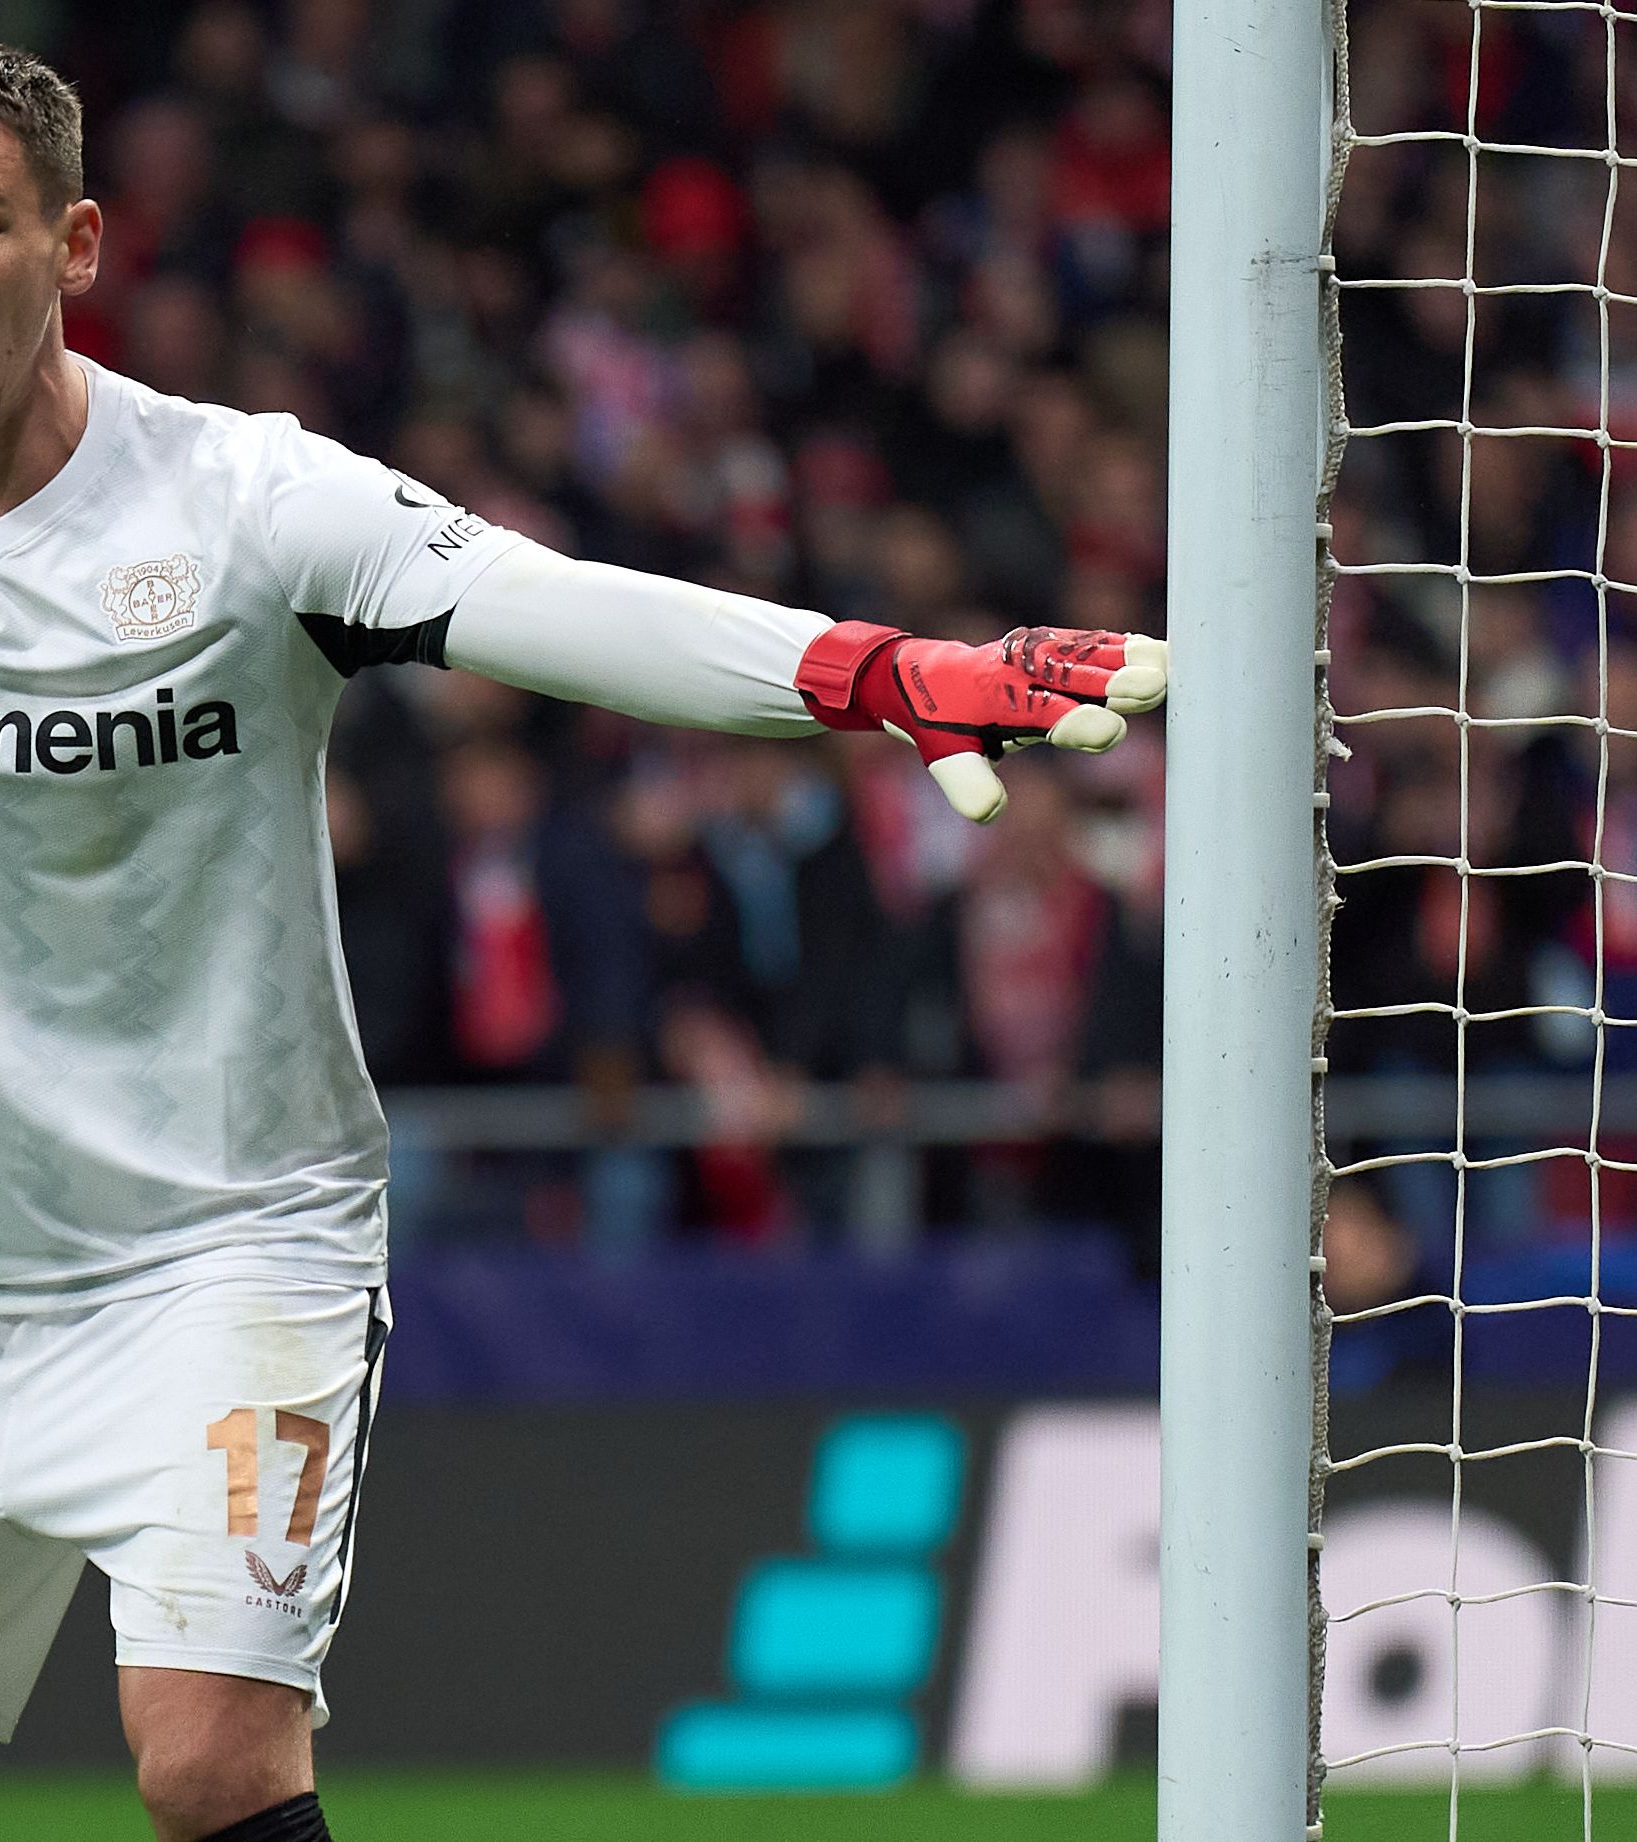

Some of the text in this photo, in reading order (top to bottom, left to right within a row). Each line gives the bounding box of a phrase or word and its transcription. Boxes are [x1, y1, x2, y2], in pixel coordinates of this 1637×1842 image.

[137, 565, 160, 577] 1904
[133, 593, 173, 608] BAYER
[123, 617, 188, 637] Leverkusen
[206, 1408, 330, 1547] 17
[245, 1595, 302, 1618] CASTORE
